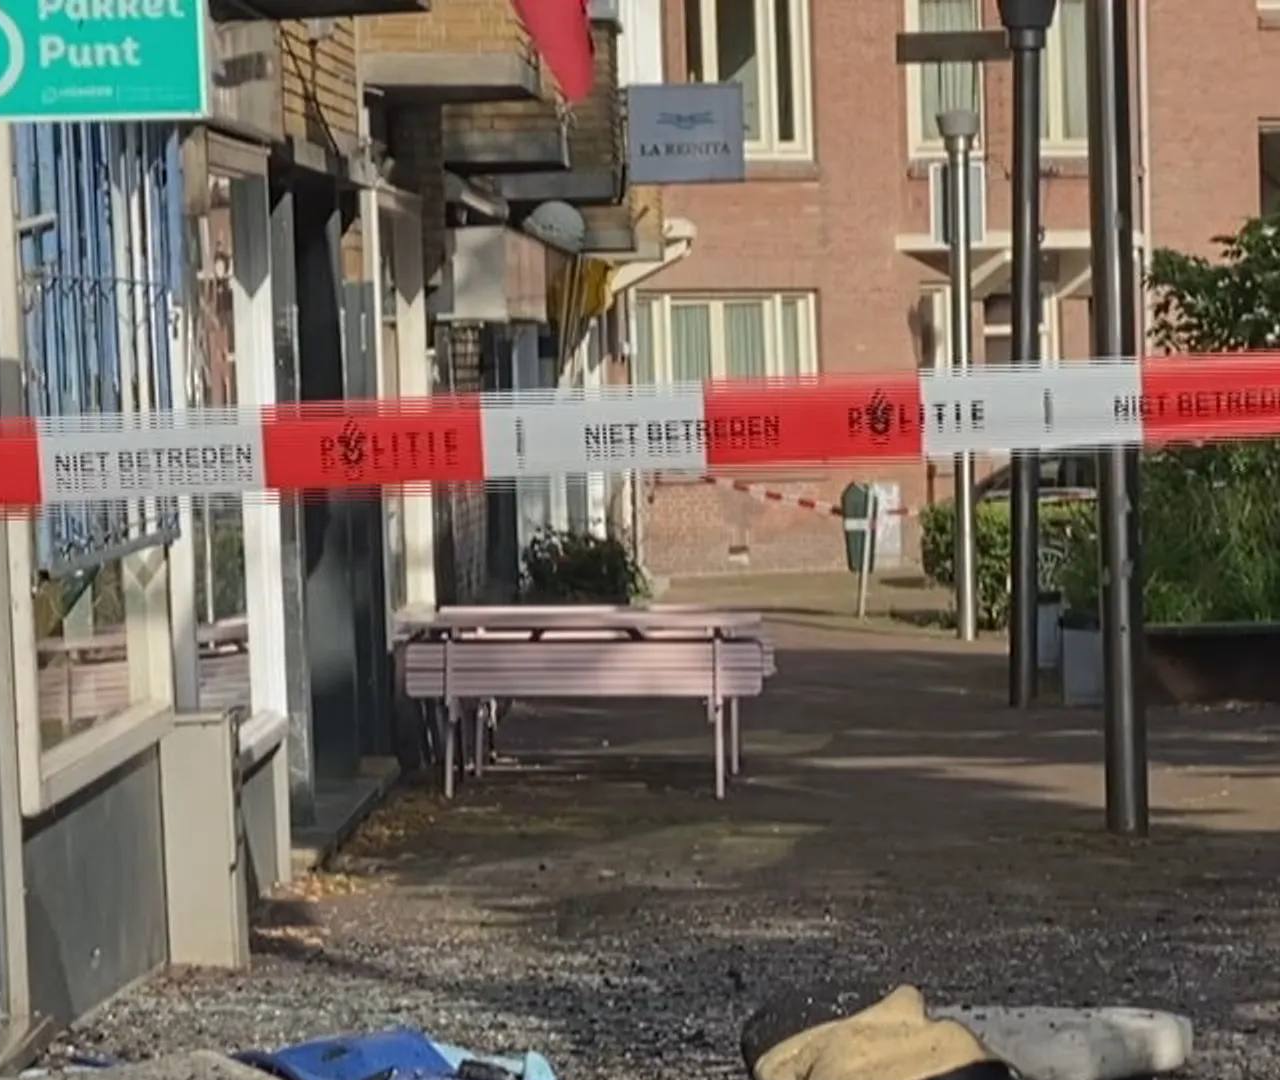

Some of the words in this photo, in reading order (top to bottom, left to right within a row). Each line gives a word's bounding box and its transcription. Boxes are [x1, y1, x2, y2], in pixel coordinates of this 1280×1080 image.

[37, 0, 185, 22] Pakket
[39, 34, 142, 68] Punt
[640, 142, 661, 157] LA
[1113, 391, 1168, 423] NIET
[583, 423, 639, 461] NIET
[646, 416, 781, 458] BETREDEN
[53, 451, 110, 494] NIET
[118, 443, 253, 488] BETREDEN
